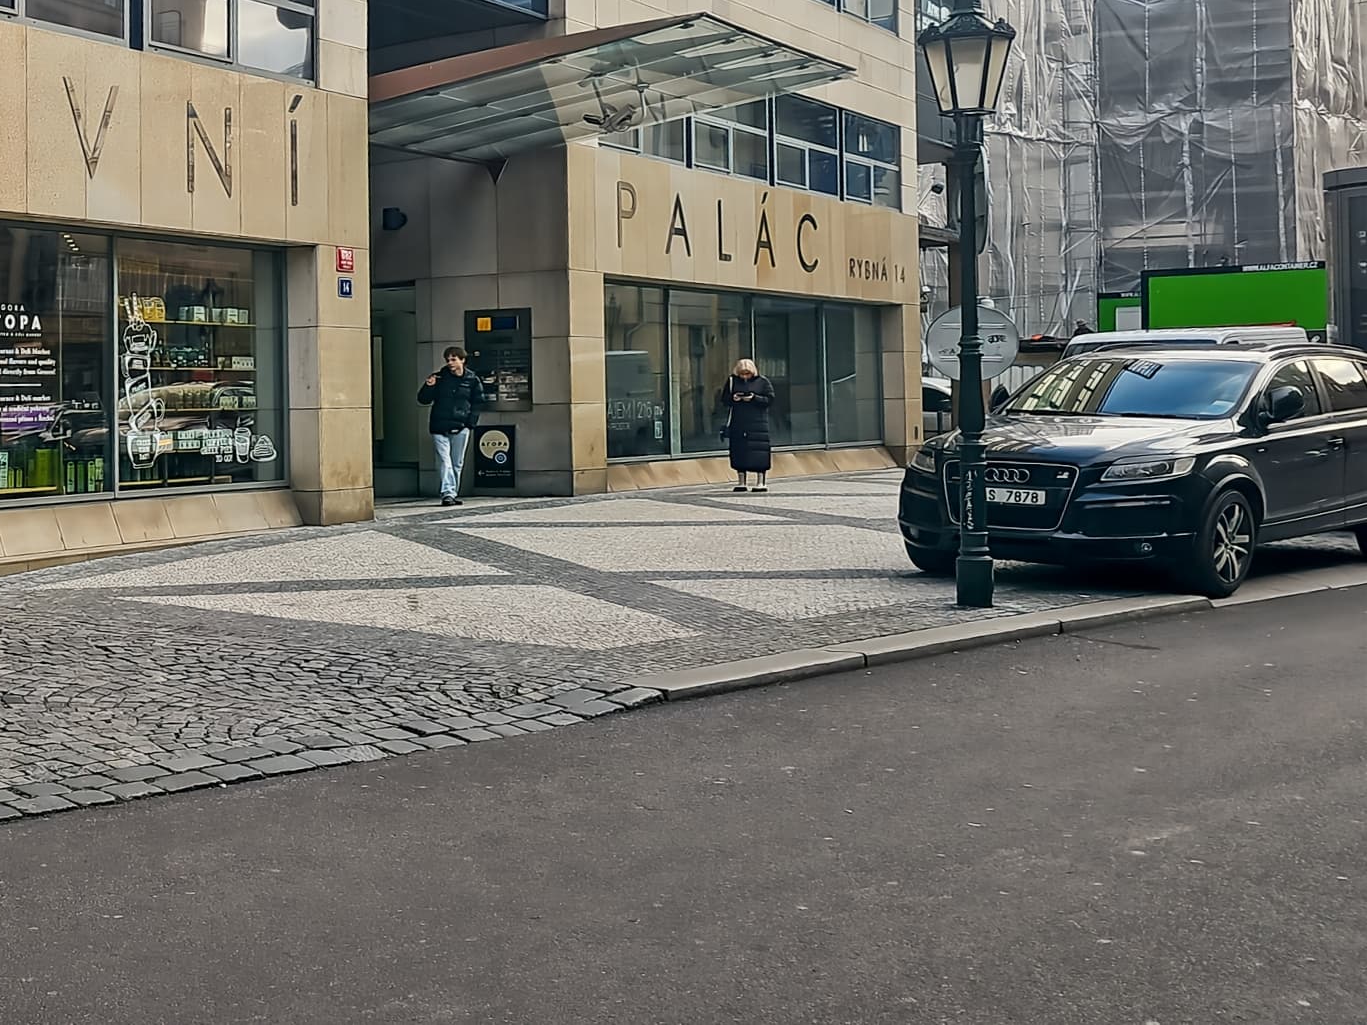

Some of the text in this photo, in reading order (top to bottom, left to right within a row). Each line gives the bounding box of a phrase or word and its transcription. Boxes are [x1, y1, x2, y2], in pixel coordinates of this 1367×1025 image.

[617, 180, 819, 273] PALÁC
[849, 257, 905, 283] RYBNÁ 14
[1005, 490, 1039, 503] 7878
